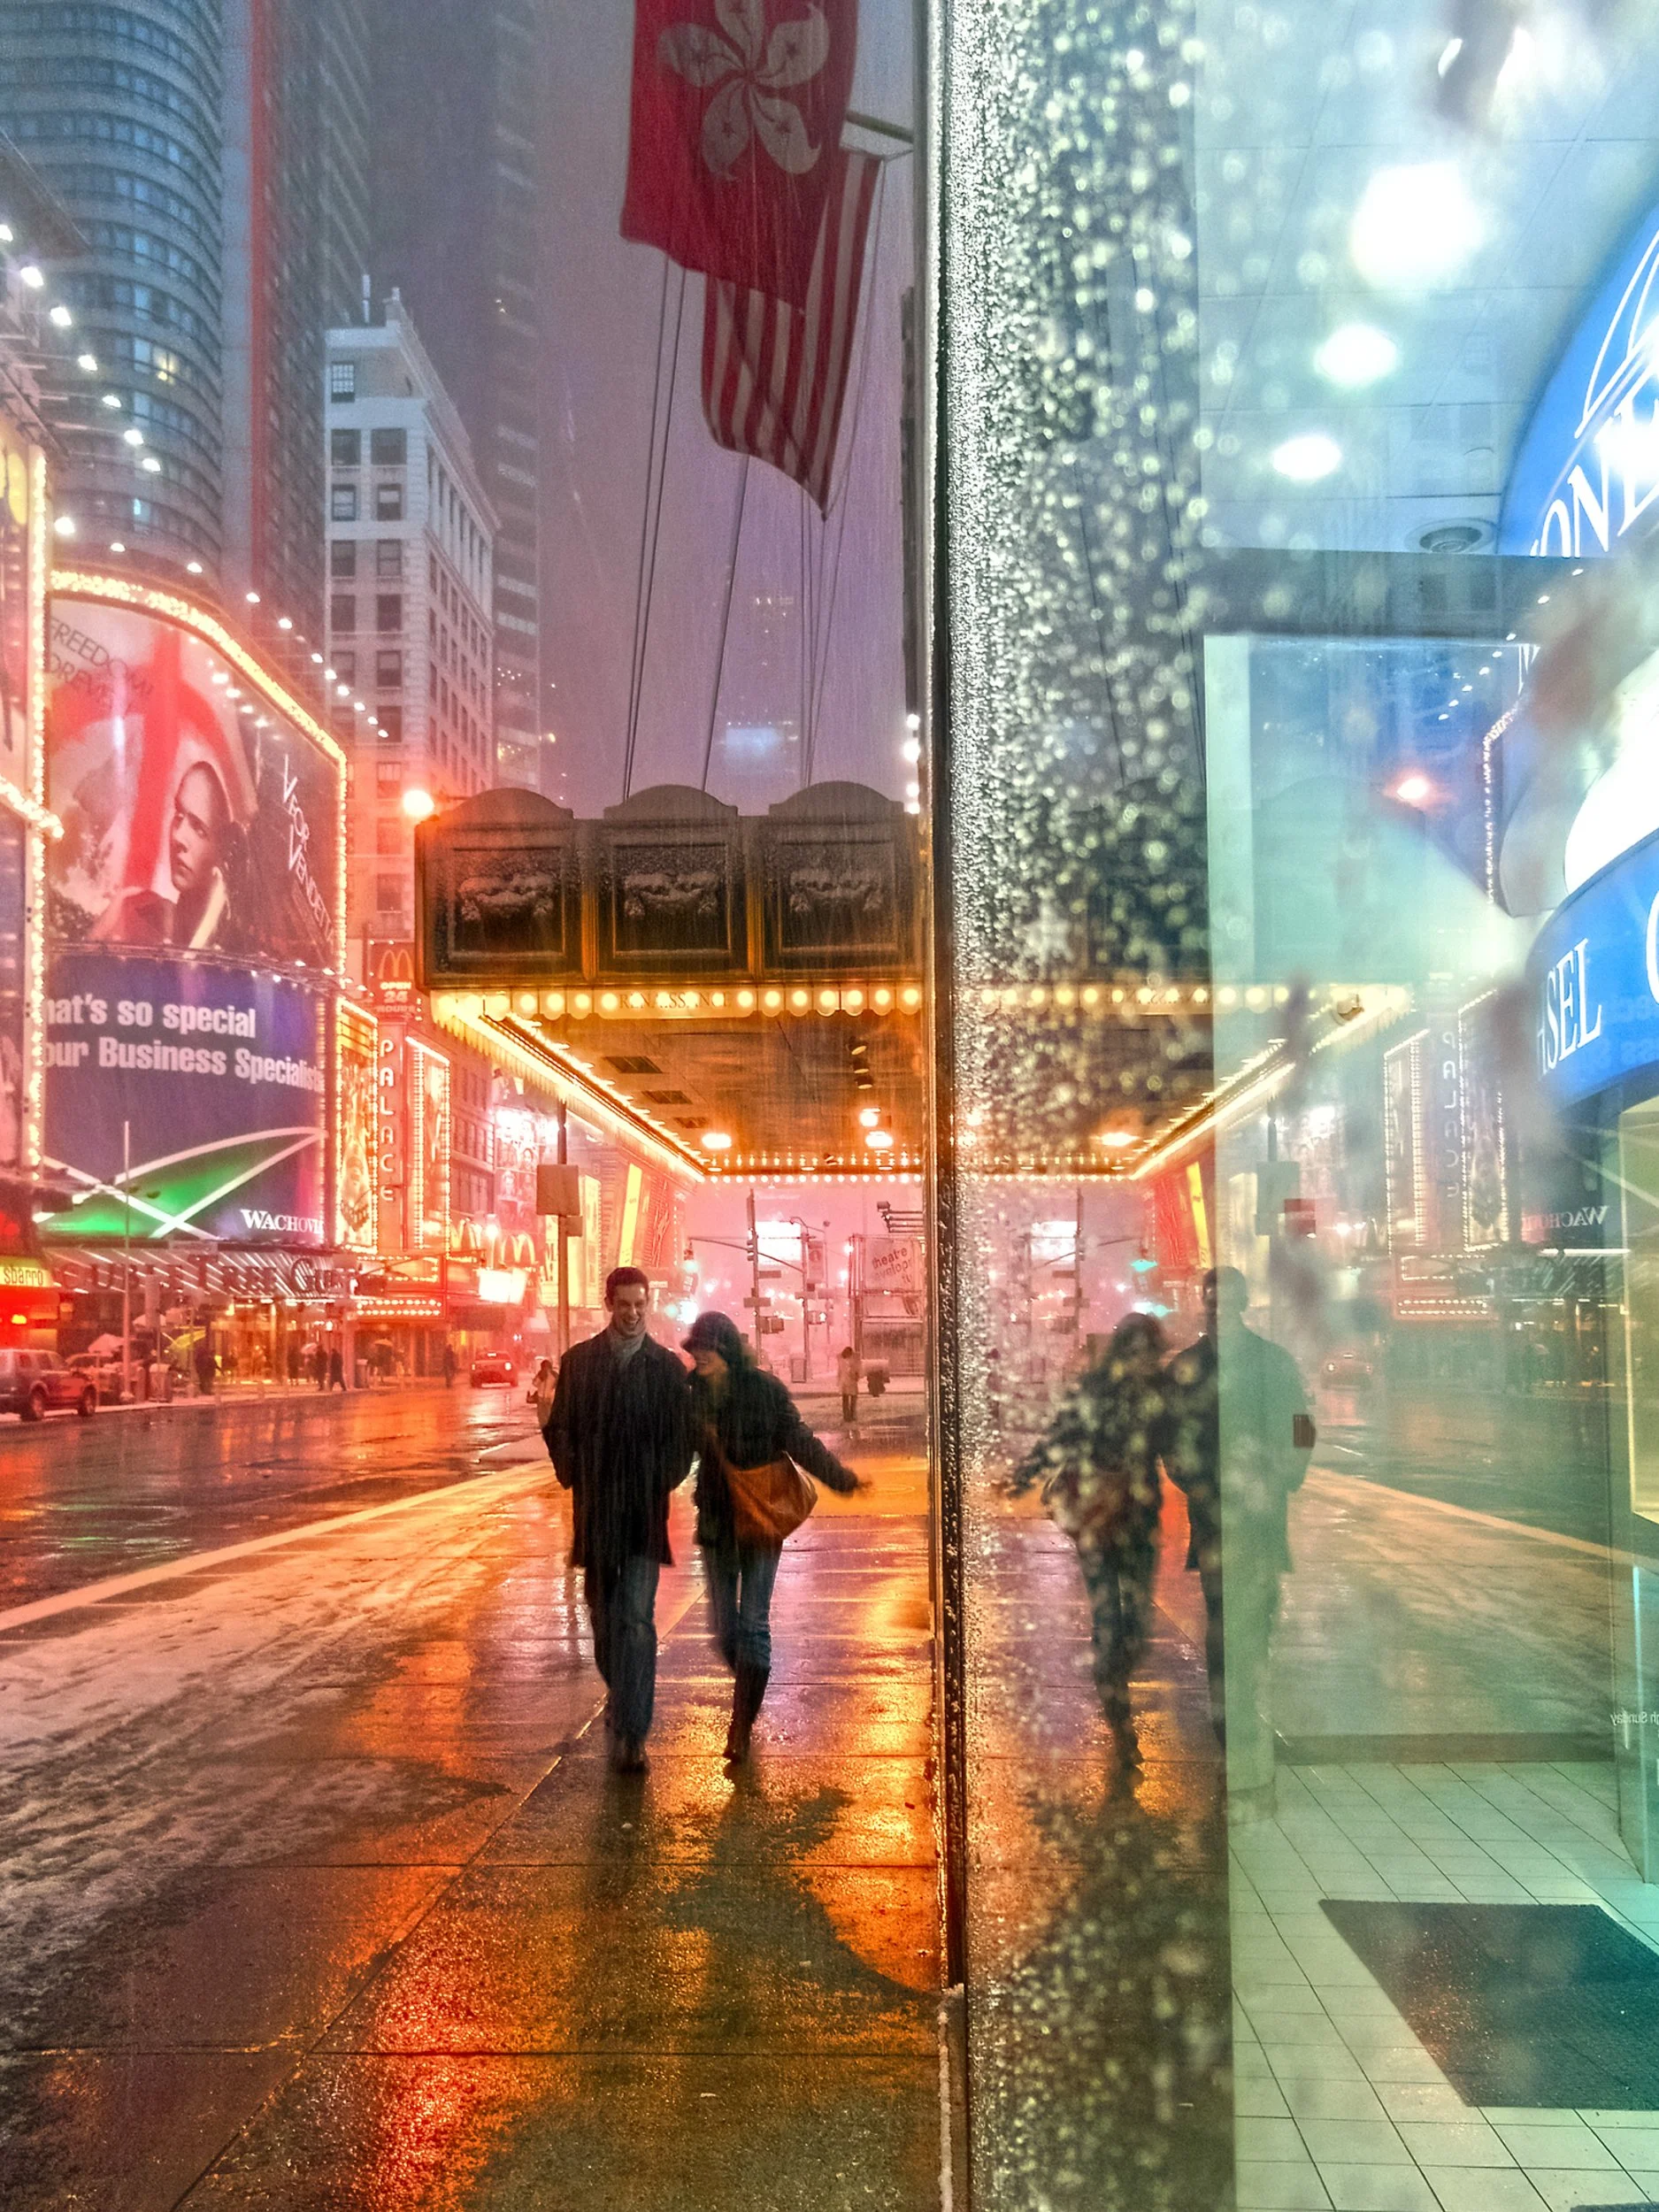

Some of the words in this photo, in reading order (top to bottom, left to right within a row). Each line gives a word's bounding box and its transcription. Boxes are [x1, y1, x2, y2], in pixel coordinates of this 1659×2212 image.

[384, 990, 408, 1003] 24
[117, 999, 153, 1027] so
[163, 1004, 256, 1039] special
[98, 1036, 227, 1076] Business
[380, 1039, 395, 1202] PALACE
[4, 1264, 43, 1286] sbarro
